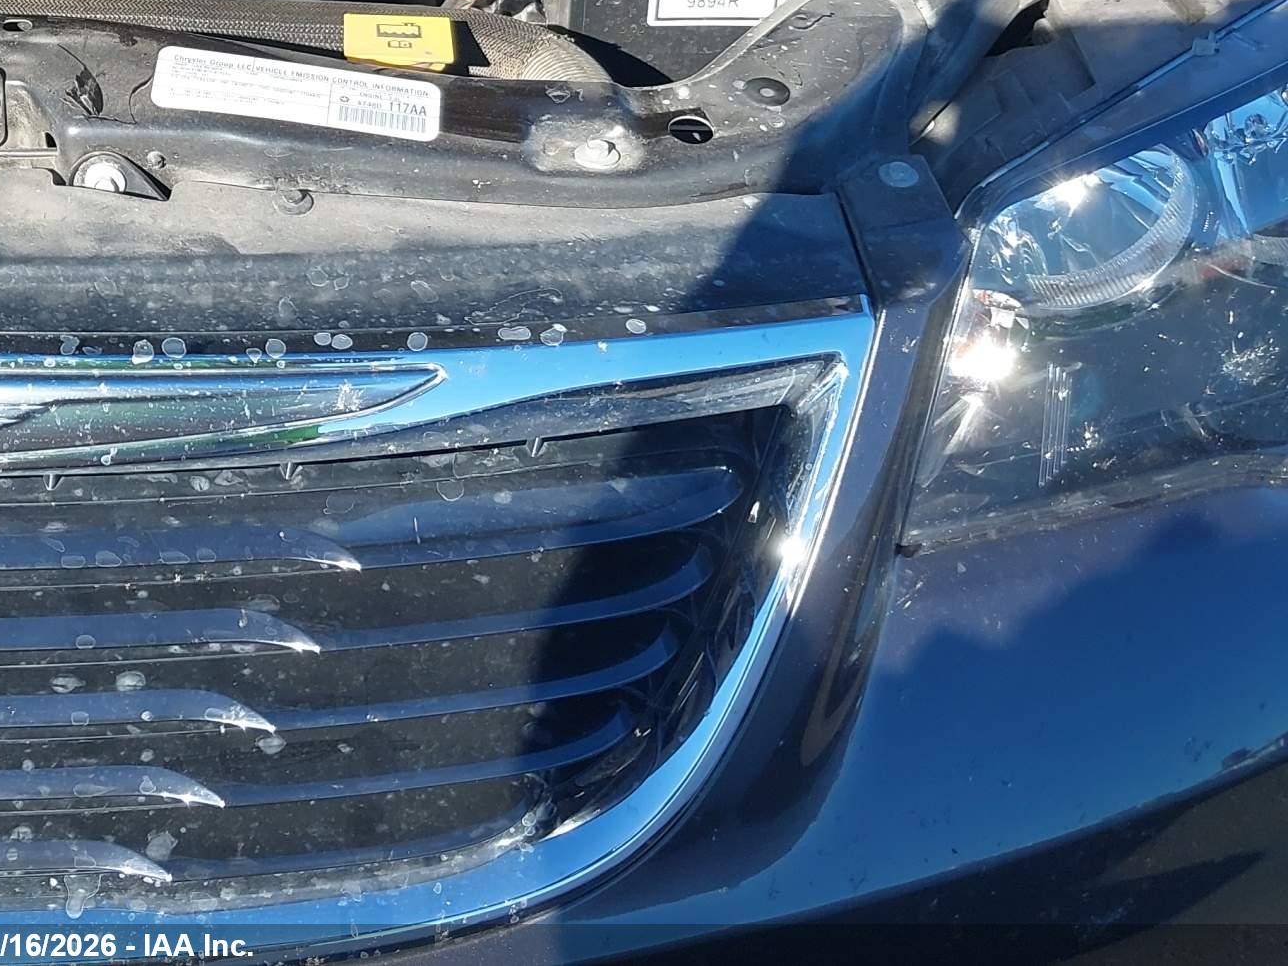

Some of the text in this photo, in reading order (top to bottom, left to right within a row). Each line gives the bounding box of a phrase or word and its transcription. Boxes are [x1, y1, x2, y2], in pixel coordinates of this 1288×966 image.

[174, 54, 207, 65] Chrysler
[210, 58, 234, 69] Group
[255, 65, 287, 76] VEHICLE
[291, 70, 329, 82] EMISSION
[332, 77, 369, 89] CONTROL
[372, 83, 429, 97] INFORMATION
[389, 101, 428, 116] 117AA
